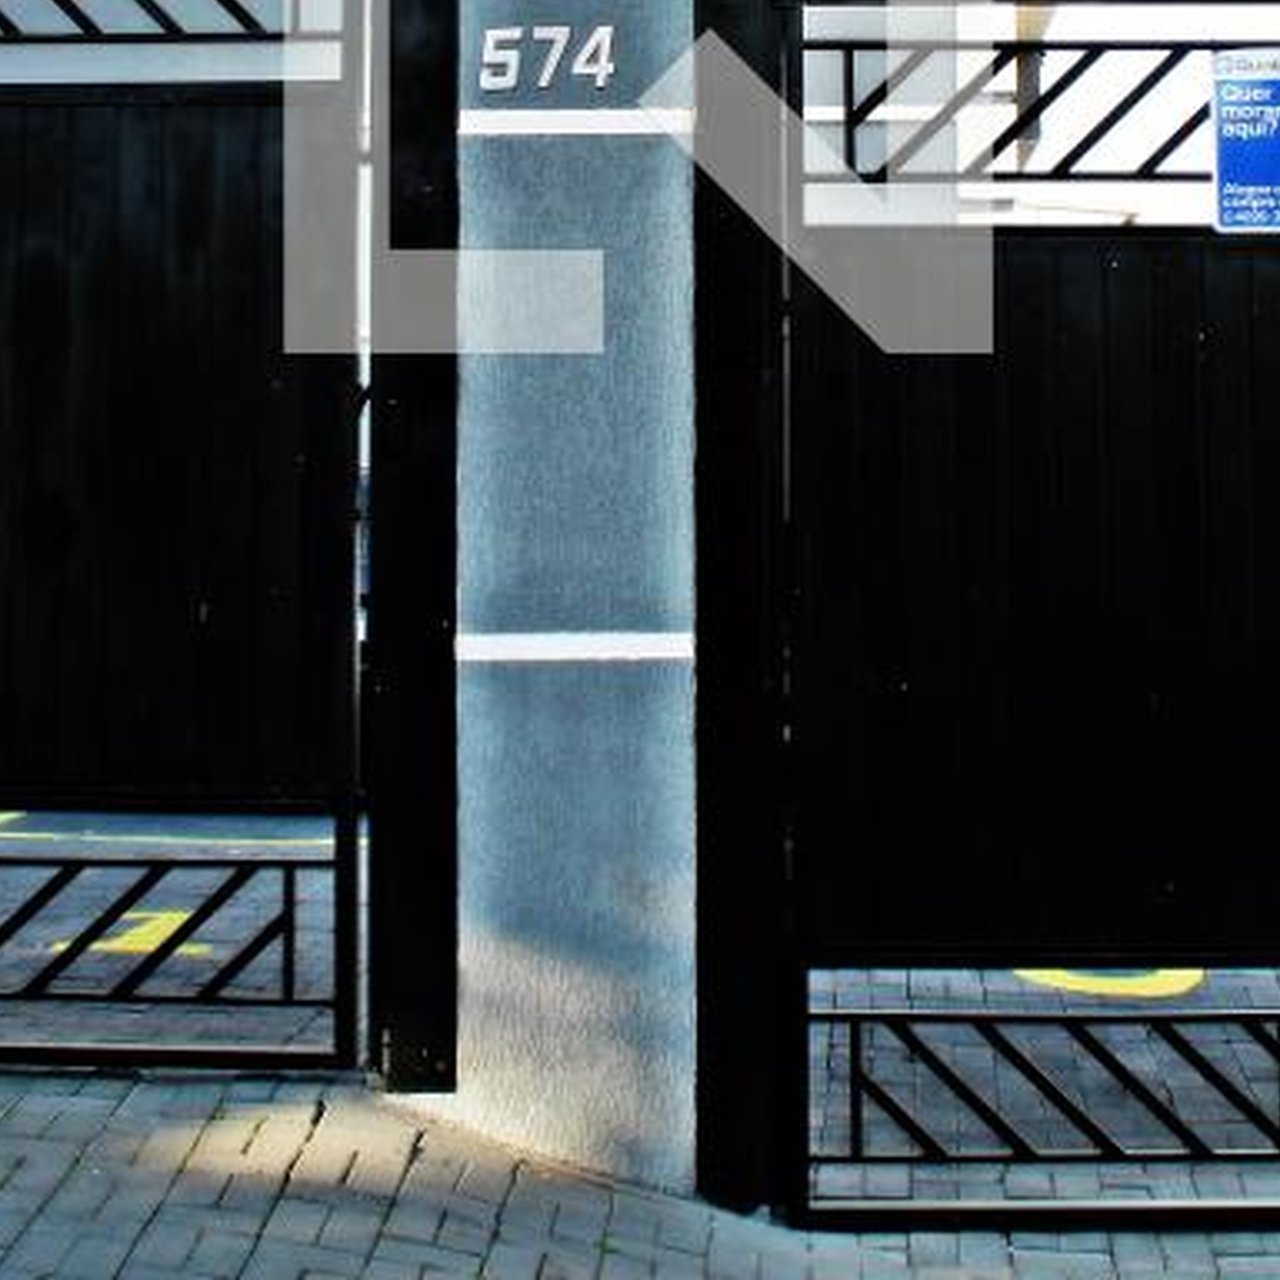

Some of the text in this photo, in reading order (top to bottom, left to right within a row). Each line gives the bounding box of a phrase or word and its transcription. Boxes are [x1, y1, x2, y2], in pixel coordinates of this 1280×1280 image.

[479, 25, 615, 90] 574
[1221, 83, 1274, 101] Quer
[1222, 120, 1278, 140] aqui?
